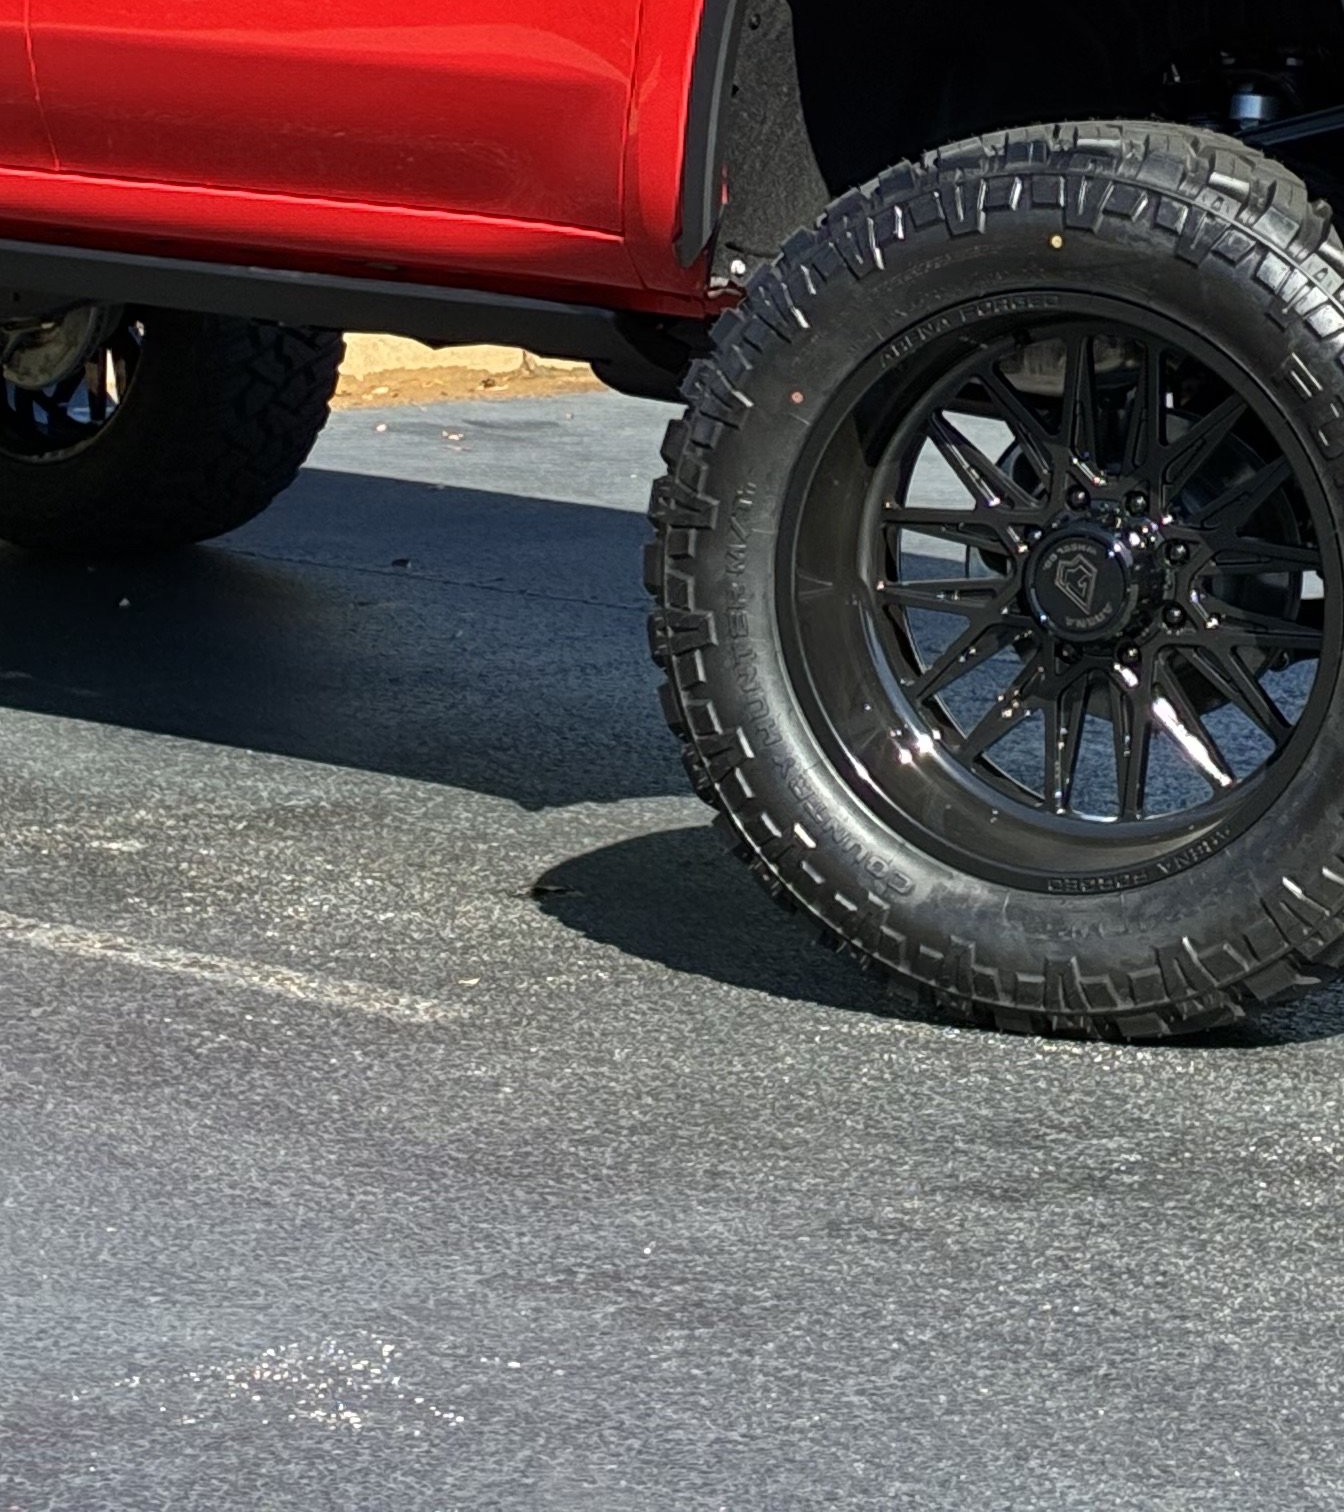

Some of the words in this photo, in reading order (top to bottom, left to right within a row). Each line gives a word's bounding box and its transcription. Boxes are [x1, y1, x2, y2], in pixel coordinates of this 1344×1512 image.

[723, 480, 758, 578] M/T
[727, 581, 784, 748] HUNTER
[772, 752, 916, 898] COUNTRY
